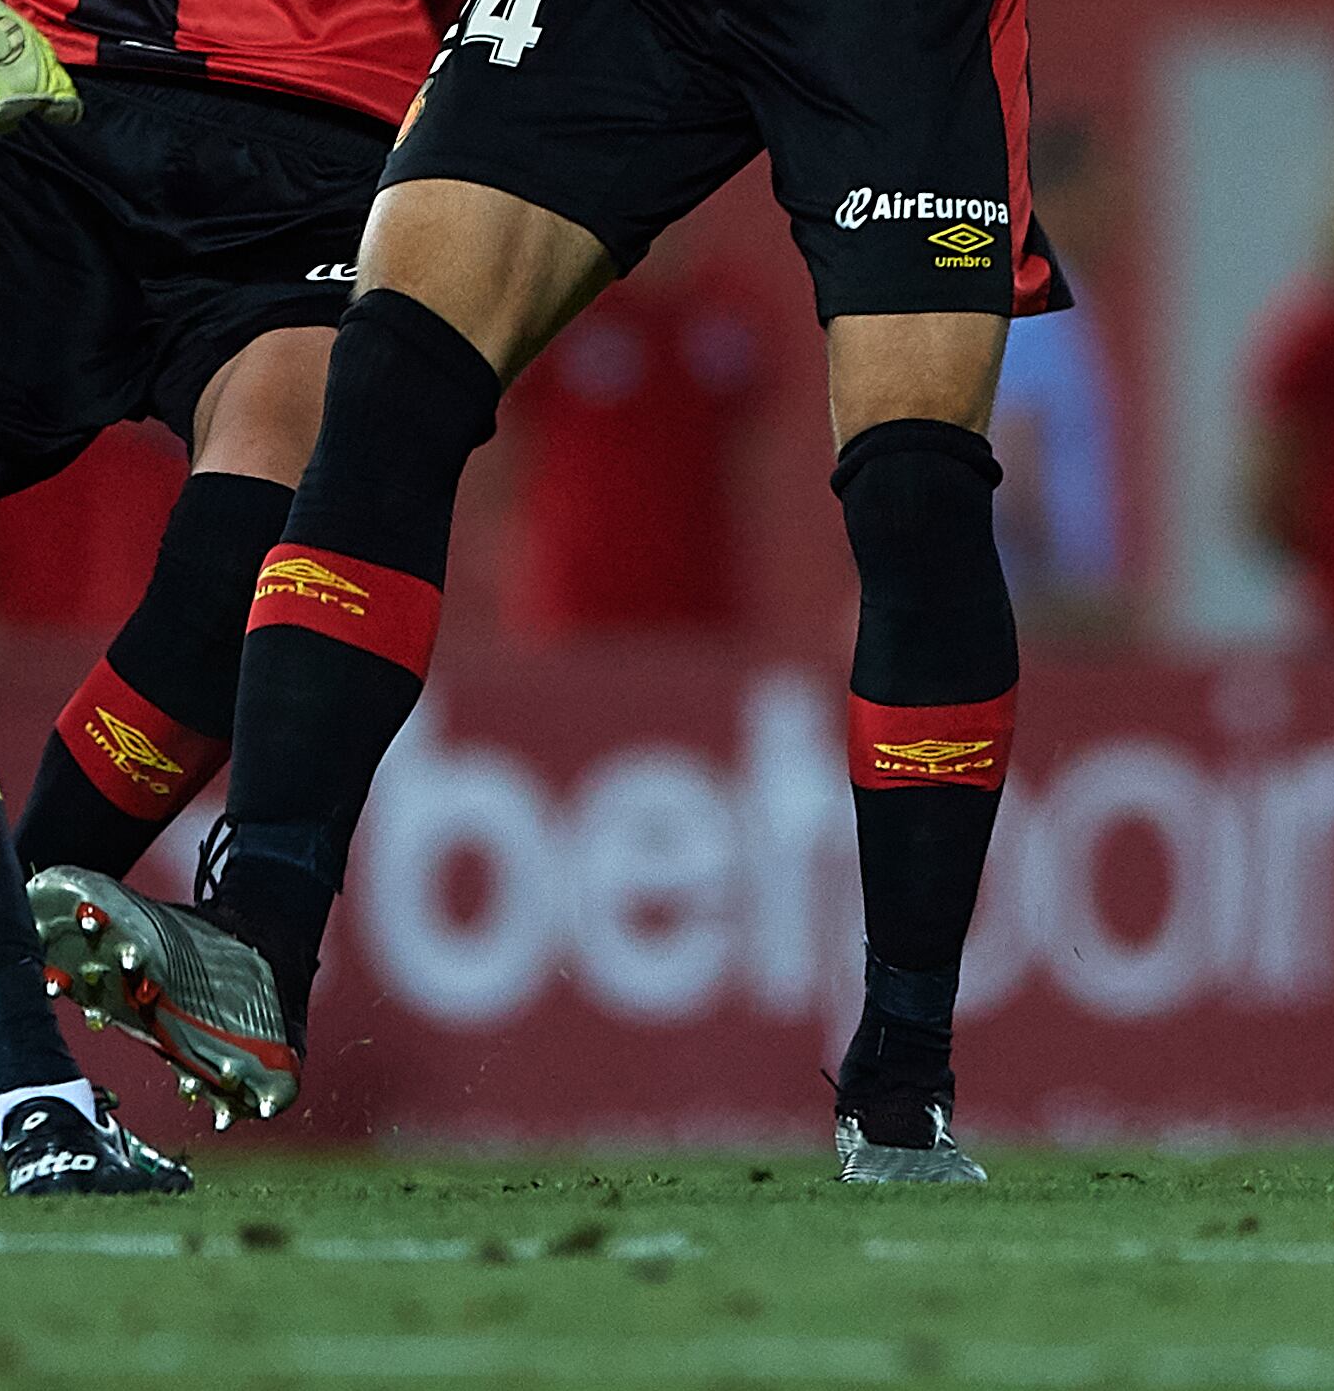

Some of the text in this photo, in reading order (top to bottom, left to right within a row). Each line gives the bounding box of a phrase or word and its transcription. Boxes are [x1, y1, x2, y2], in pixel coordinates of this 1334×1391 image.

[872, 191, 1009, 227] AirEuropa
[935, 255, 991, 268] umbro
[255, 582, 365, 616] umbro
[85, 721, 170, 795] umbro
[875, 758, 994, 774] umbro
[9, 1150, 98, 1193] lotto
